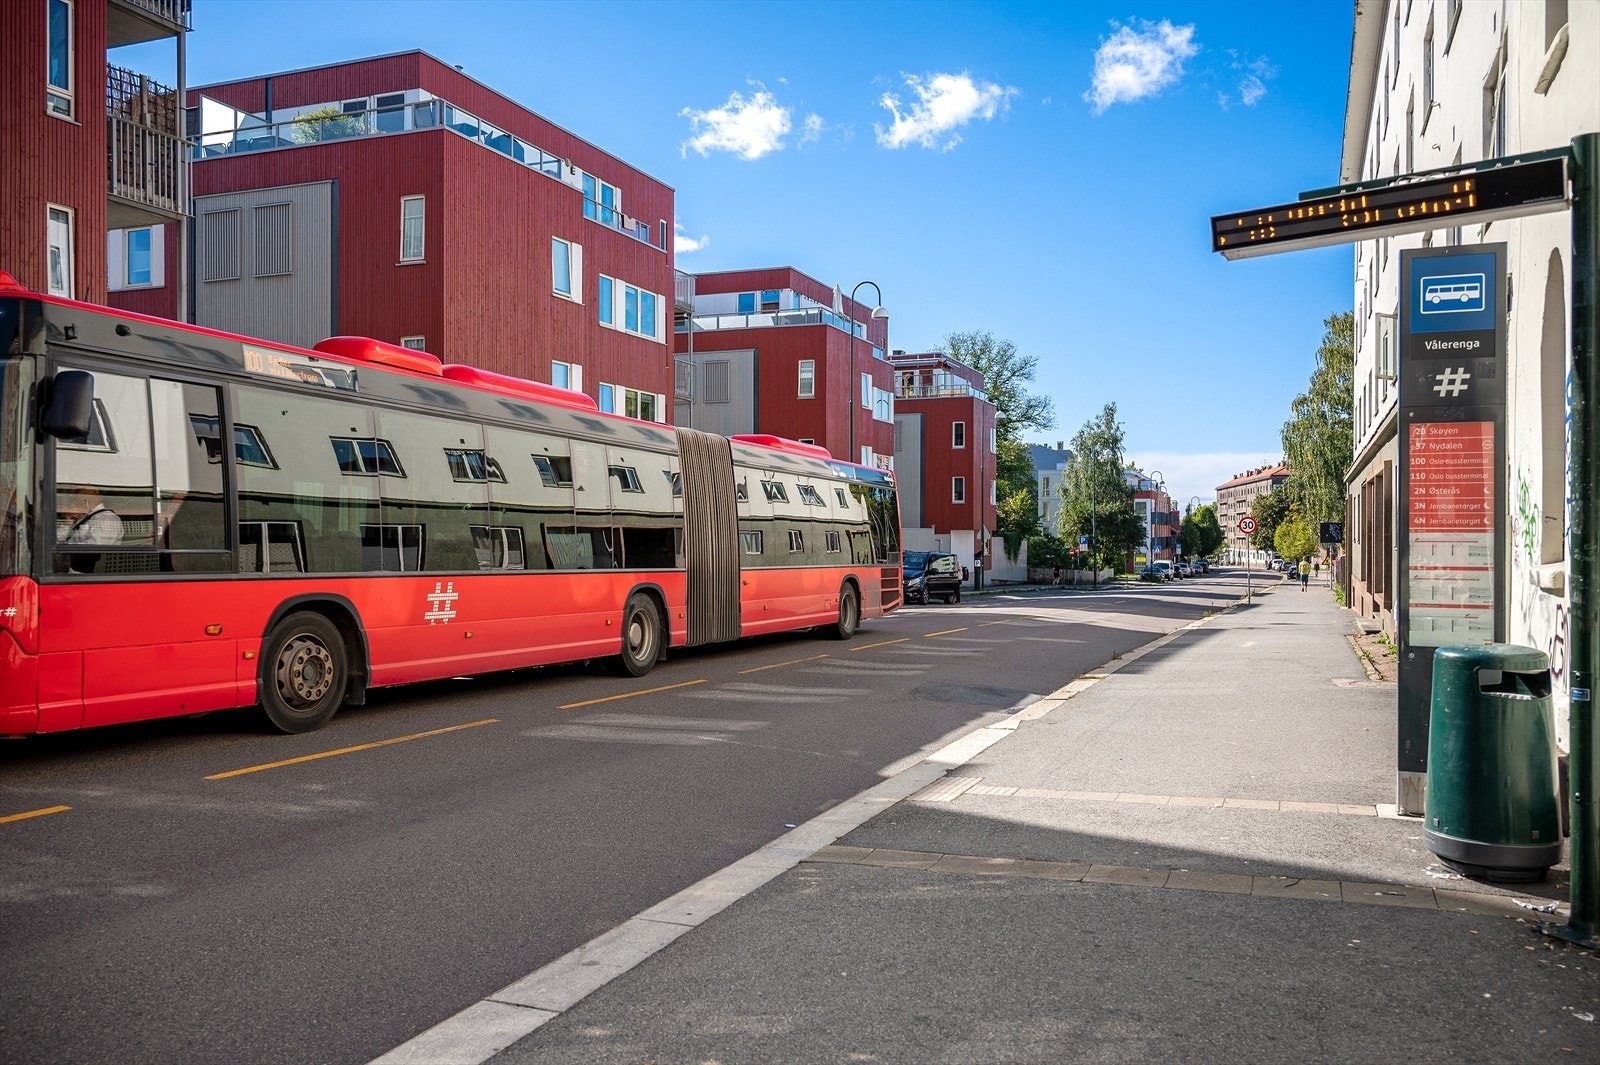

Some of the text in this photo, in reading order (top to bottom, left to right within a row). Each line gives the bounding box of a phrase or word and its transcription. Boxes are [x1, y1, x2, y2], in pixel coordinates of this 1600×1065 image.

[1424, 339, 1480, 350] Vålerenga
[245, 350, 263, 372] 100
[1429, 427, 1459, 436] Skøyen
[1429, 442, 1463, 451] Nydalen
[1410, 457, 1426, 465] 100
[1445, 457, 1489, 465] bussterminal
[1410, 472, 1426, 480] 110
[1445, 472, 1489, 480] bussterminal
[1414, 486, 1460, 495] 2N Østerås
[1414, 502, 1481, 511] 3N Jernbanetorget
[1242, 520, 1254, 530] 30
[1414, 517, 1481, 526] 4N Jernbanetorget
